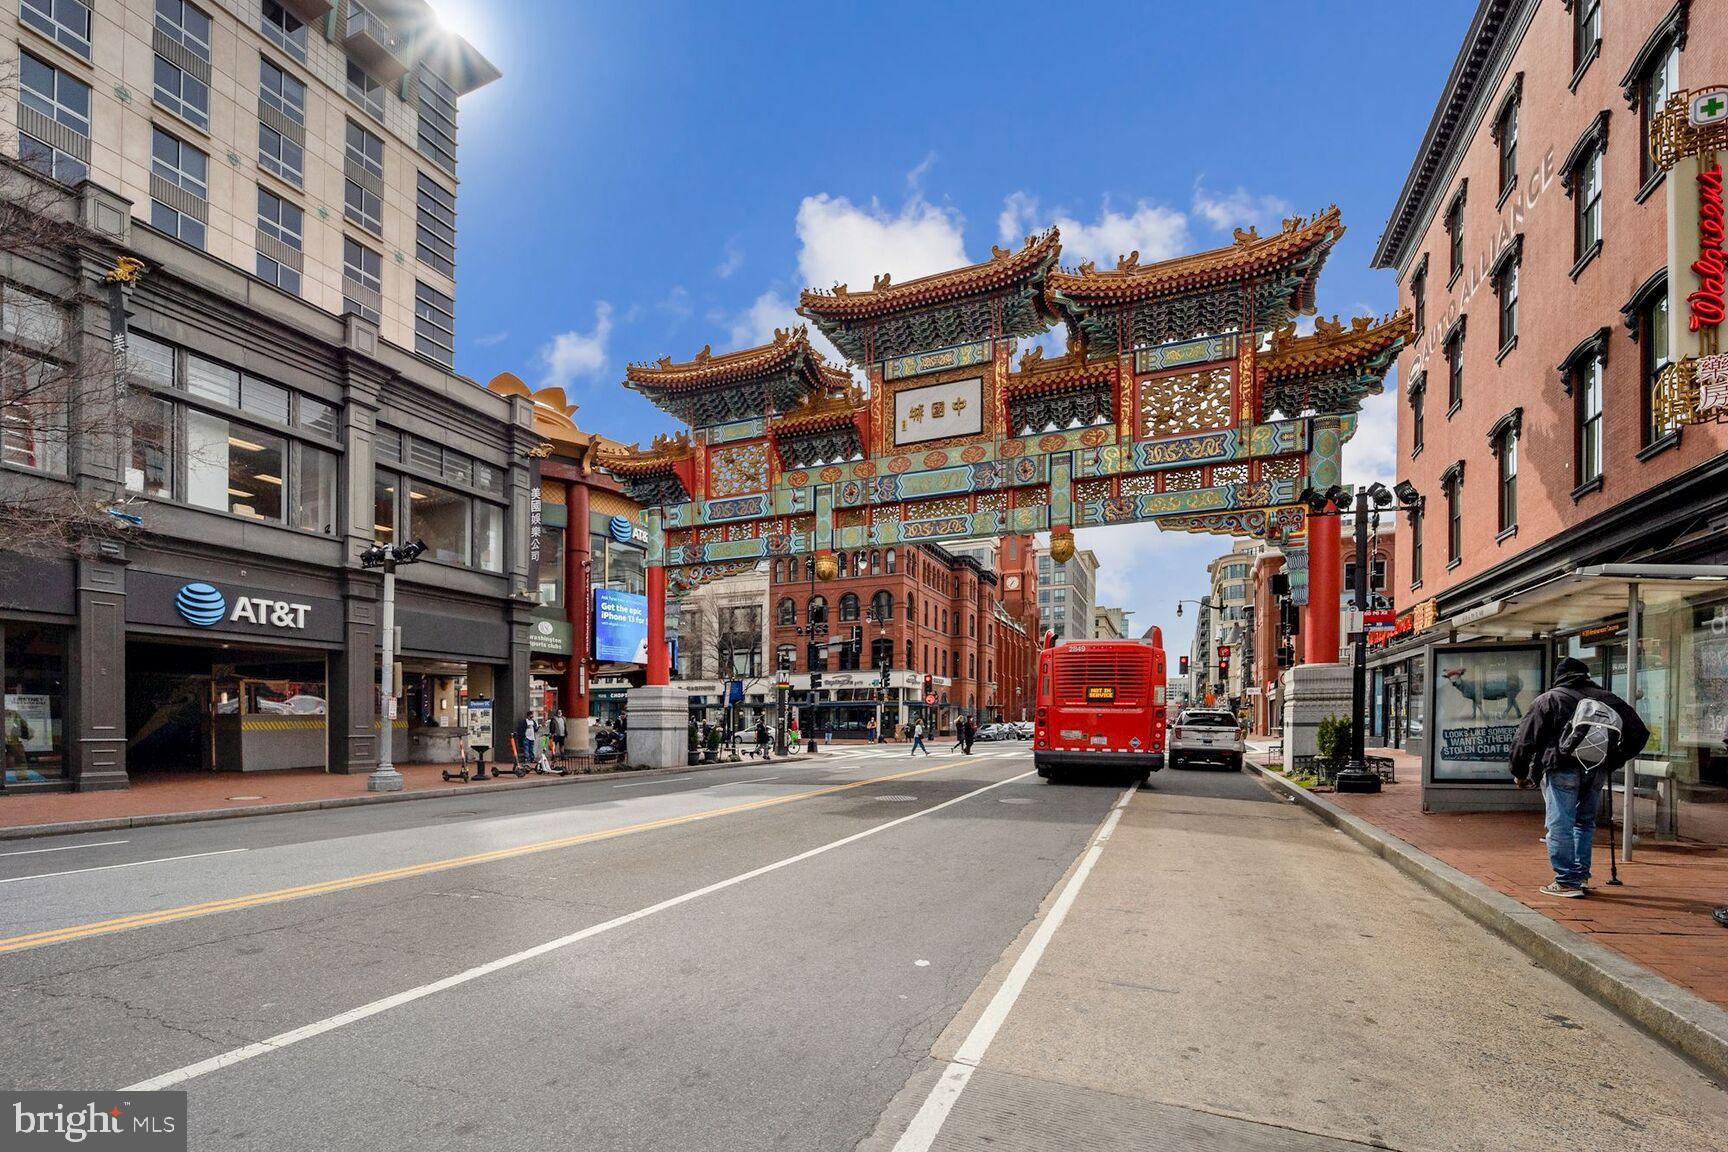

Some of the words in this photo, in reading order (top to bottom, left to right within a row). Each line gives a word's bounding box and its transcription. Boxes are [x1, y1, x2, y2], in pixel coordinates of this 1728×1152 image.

[1459, 143, 1554, 315] ALLIANCE
[1687, 163, 1728, 333] Walgreens
[230, 596, 312, 629] AT&T
[601, 602, 615, 611] Get
[617, 604, 629, 614] the
[630, 607, 642, 615] epic
[601, 611, 626, 621] iPhone
[1444, 729, 1467, 739] LOOKS
[1470, 728, 1486, 737] LIKE
[1450, 736, 1484, 746] WANTS
[1486, 734, 1513, 744] THEIR
[1444, 745, 1475, 755] STOLEN
[1477, 744, 1501, 753] COAT
